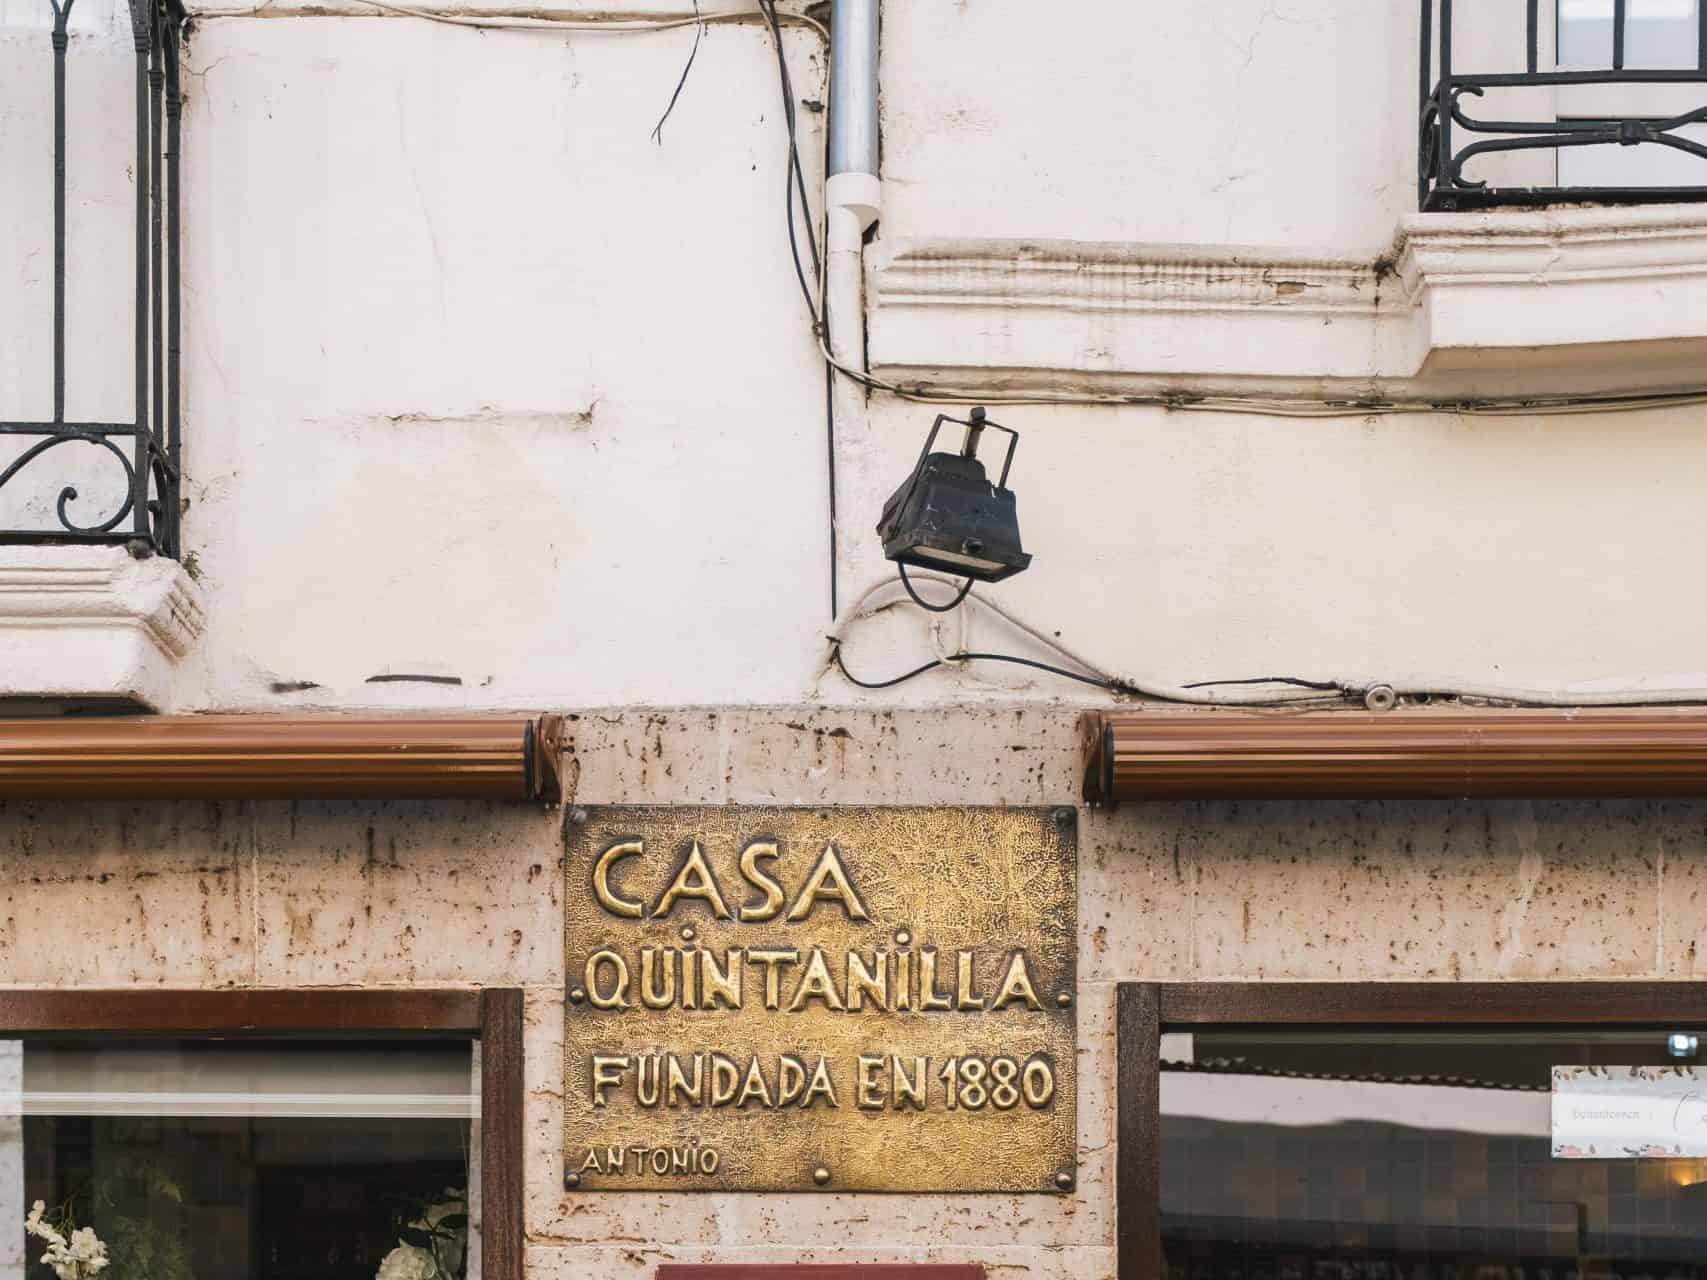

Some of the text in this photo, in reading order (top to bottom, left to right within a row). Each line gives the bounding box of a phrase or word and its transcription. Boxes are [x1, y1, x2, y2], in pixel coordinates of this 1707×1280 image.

[592, 840, 870, 922] CASA
[584, 930, 1041, 1011] QUINTANILLA
[593, 1054, 1054, 1110] FUNDADA EN 1880
[580, 1142, 719, 1176] ANTONIO
